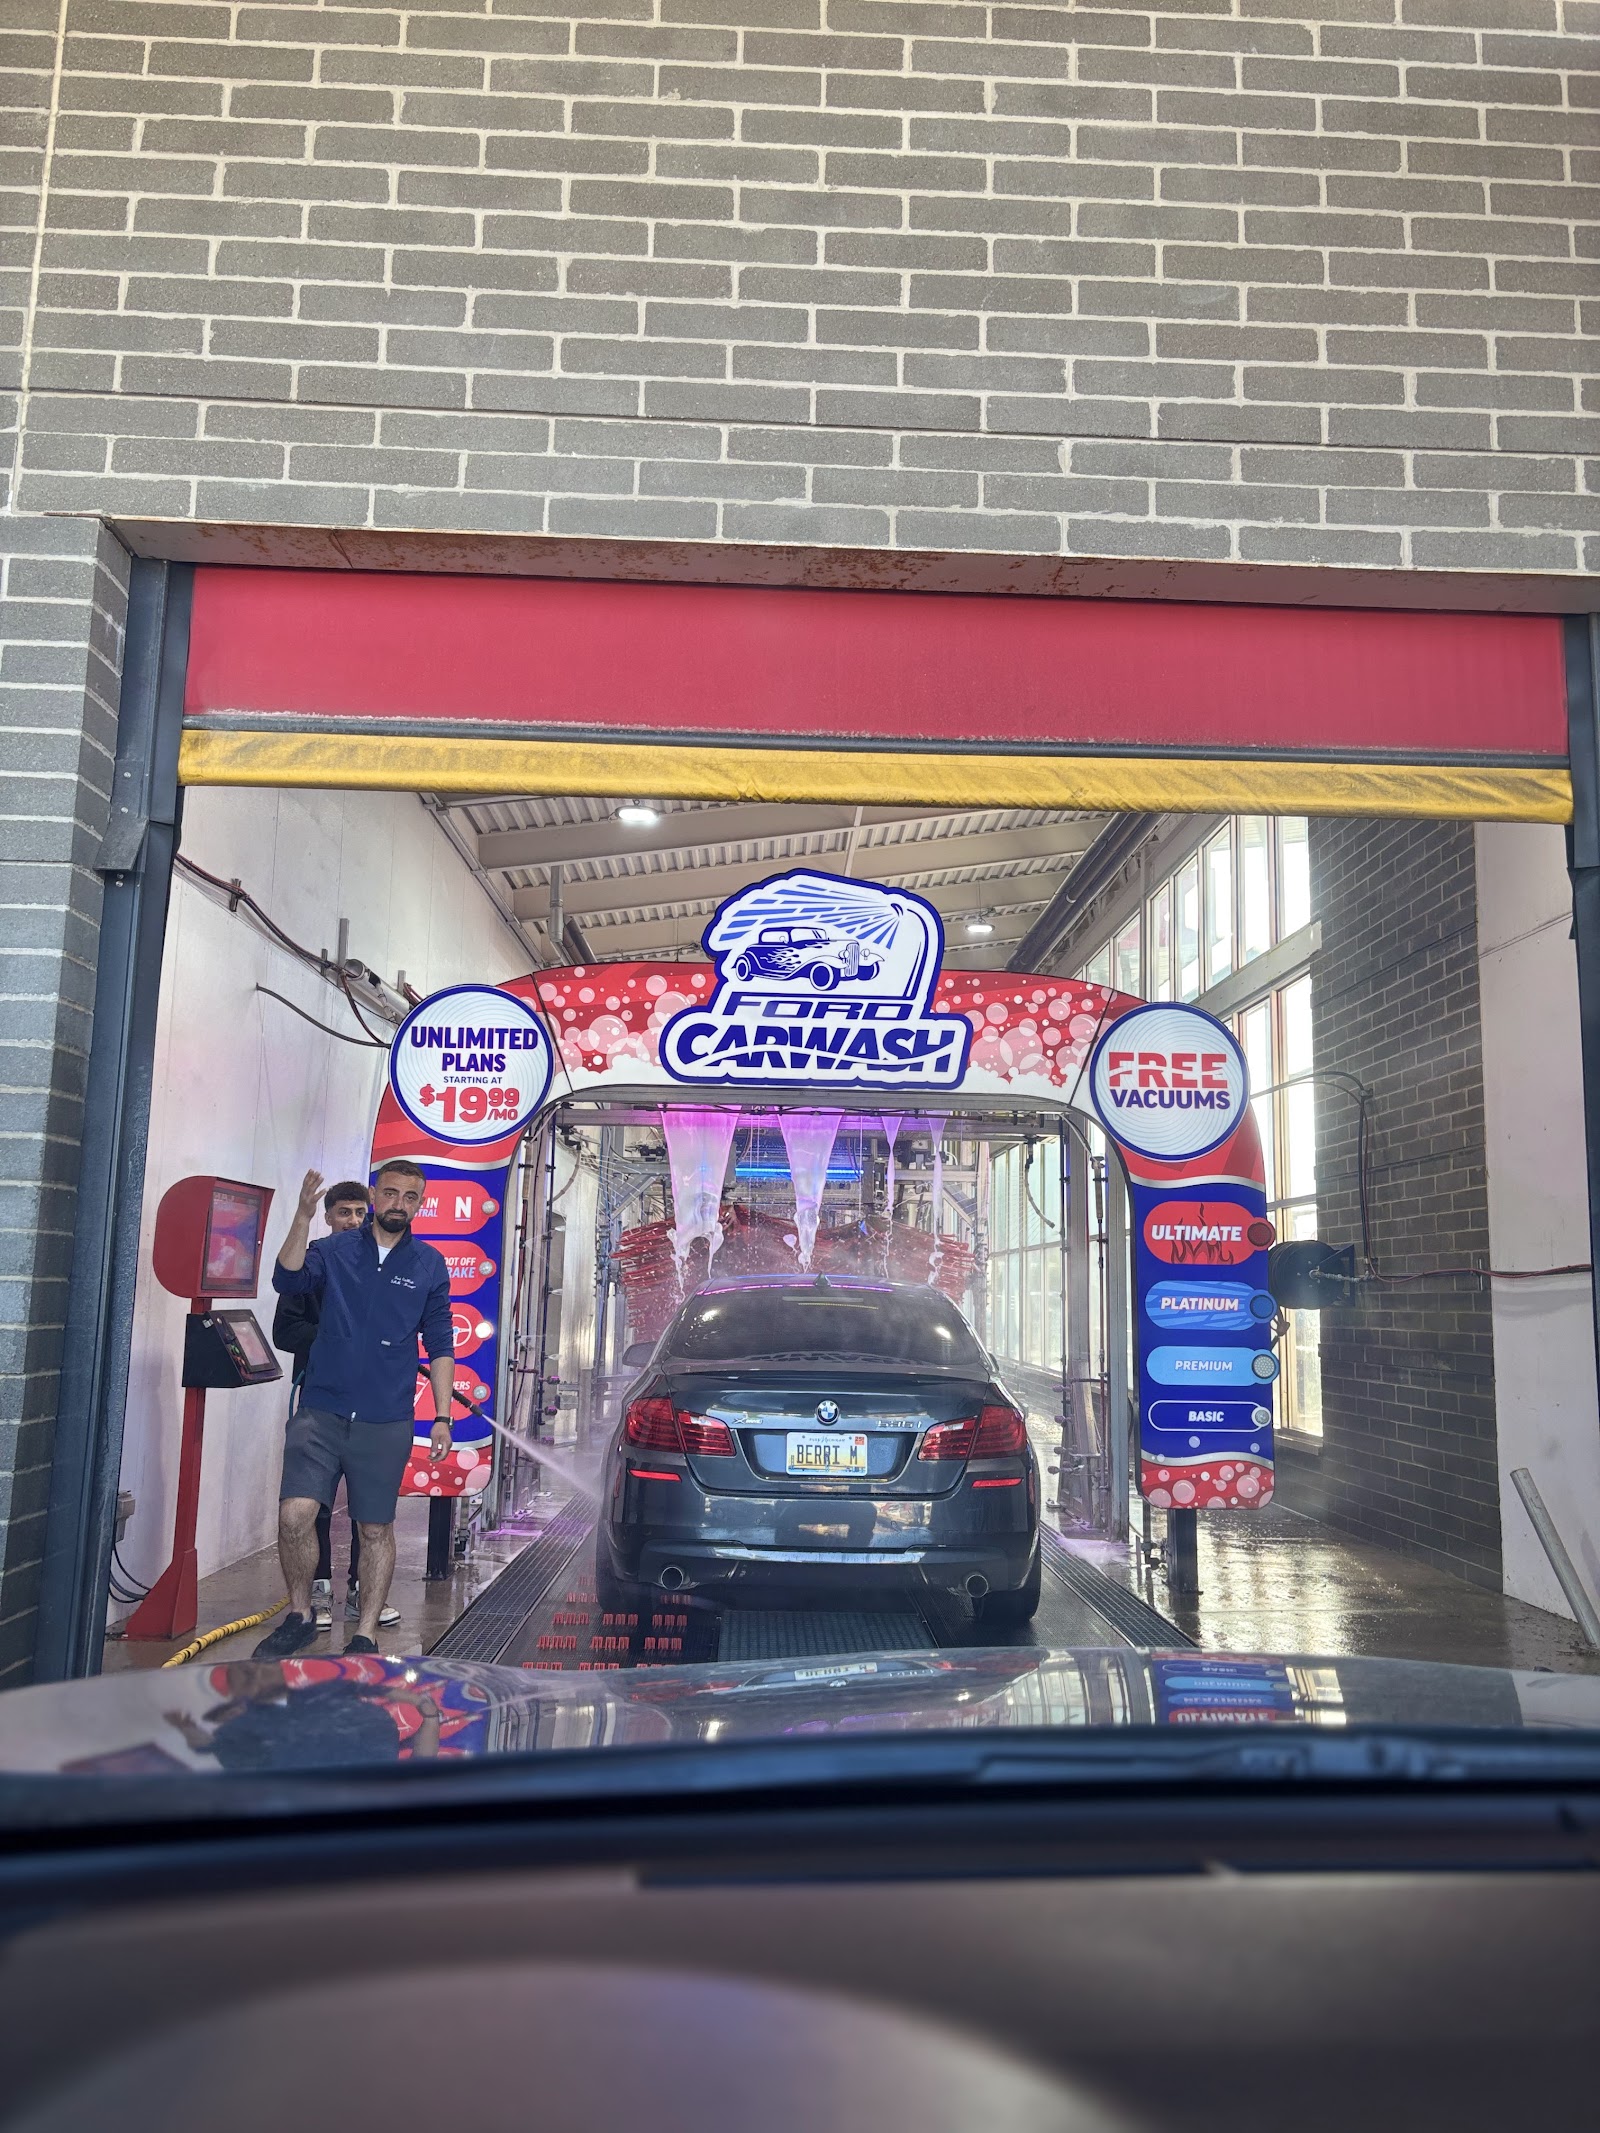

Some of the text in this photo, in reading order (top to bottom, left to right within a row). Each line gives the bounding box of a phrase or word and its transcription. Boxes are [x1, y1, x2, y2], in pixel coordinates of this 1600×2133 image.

[721, 992, 914, 1021] FORD
[410, 1026, 539, 1050] UNLIMITED
[676, 1022, 956, 1073] CARWASH
[441, 1052, 507, 1073] PLANS
[1108, 1052, 1228, 1089] FREE
[443, 1075, 503, 1085] STARTING AT
[1109, 1088, 1231, 1110] VACUUMS
[426, 1197, 439, 1209] IN
[454, 1196, 473, 1219] N
[1151, 1224, 1243, 1242] ULTIMATE
[460, 1257, 477, 1266] OFF
[447, 1266, 477, 1279] RAKE
[1160, 1297, 1239, 1311] PLATINUM
[1174, 1360, 1234, 1371] PREMIUM
[1187, 1410, 1225, 1423] BASIC
[796, 1444, 858, 1465] BERRI M
